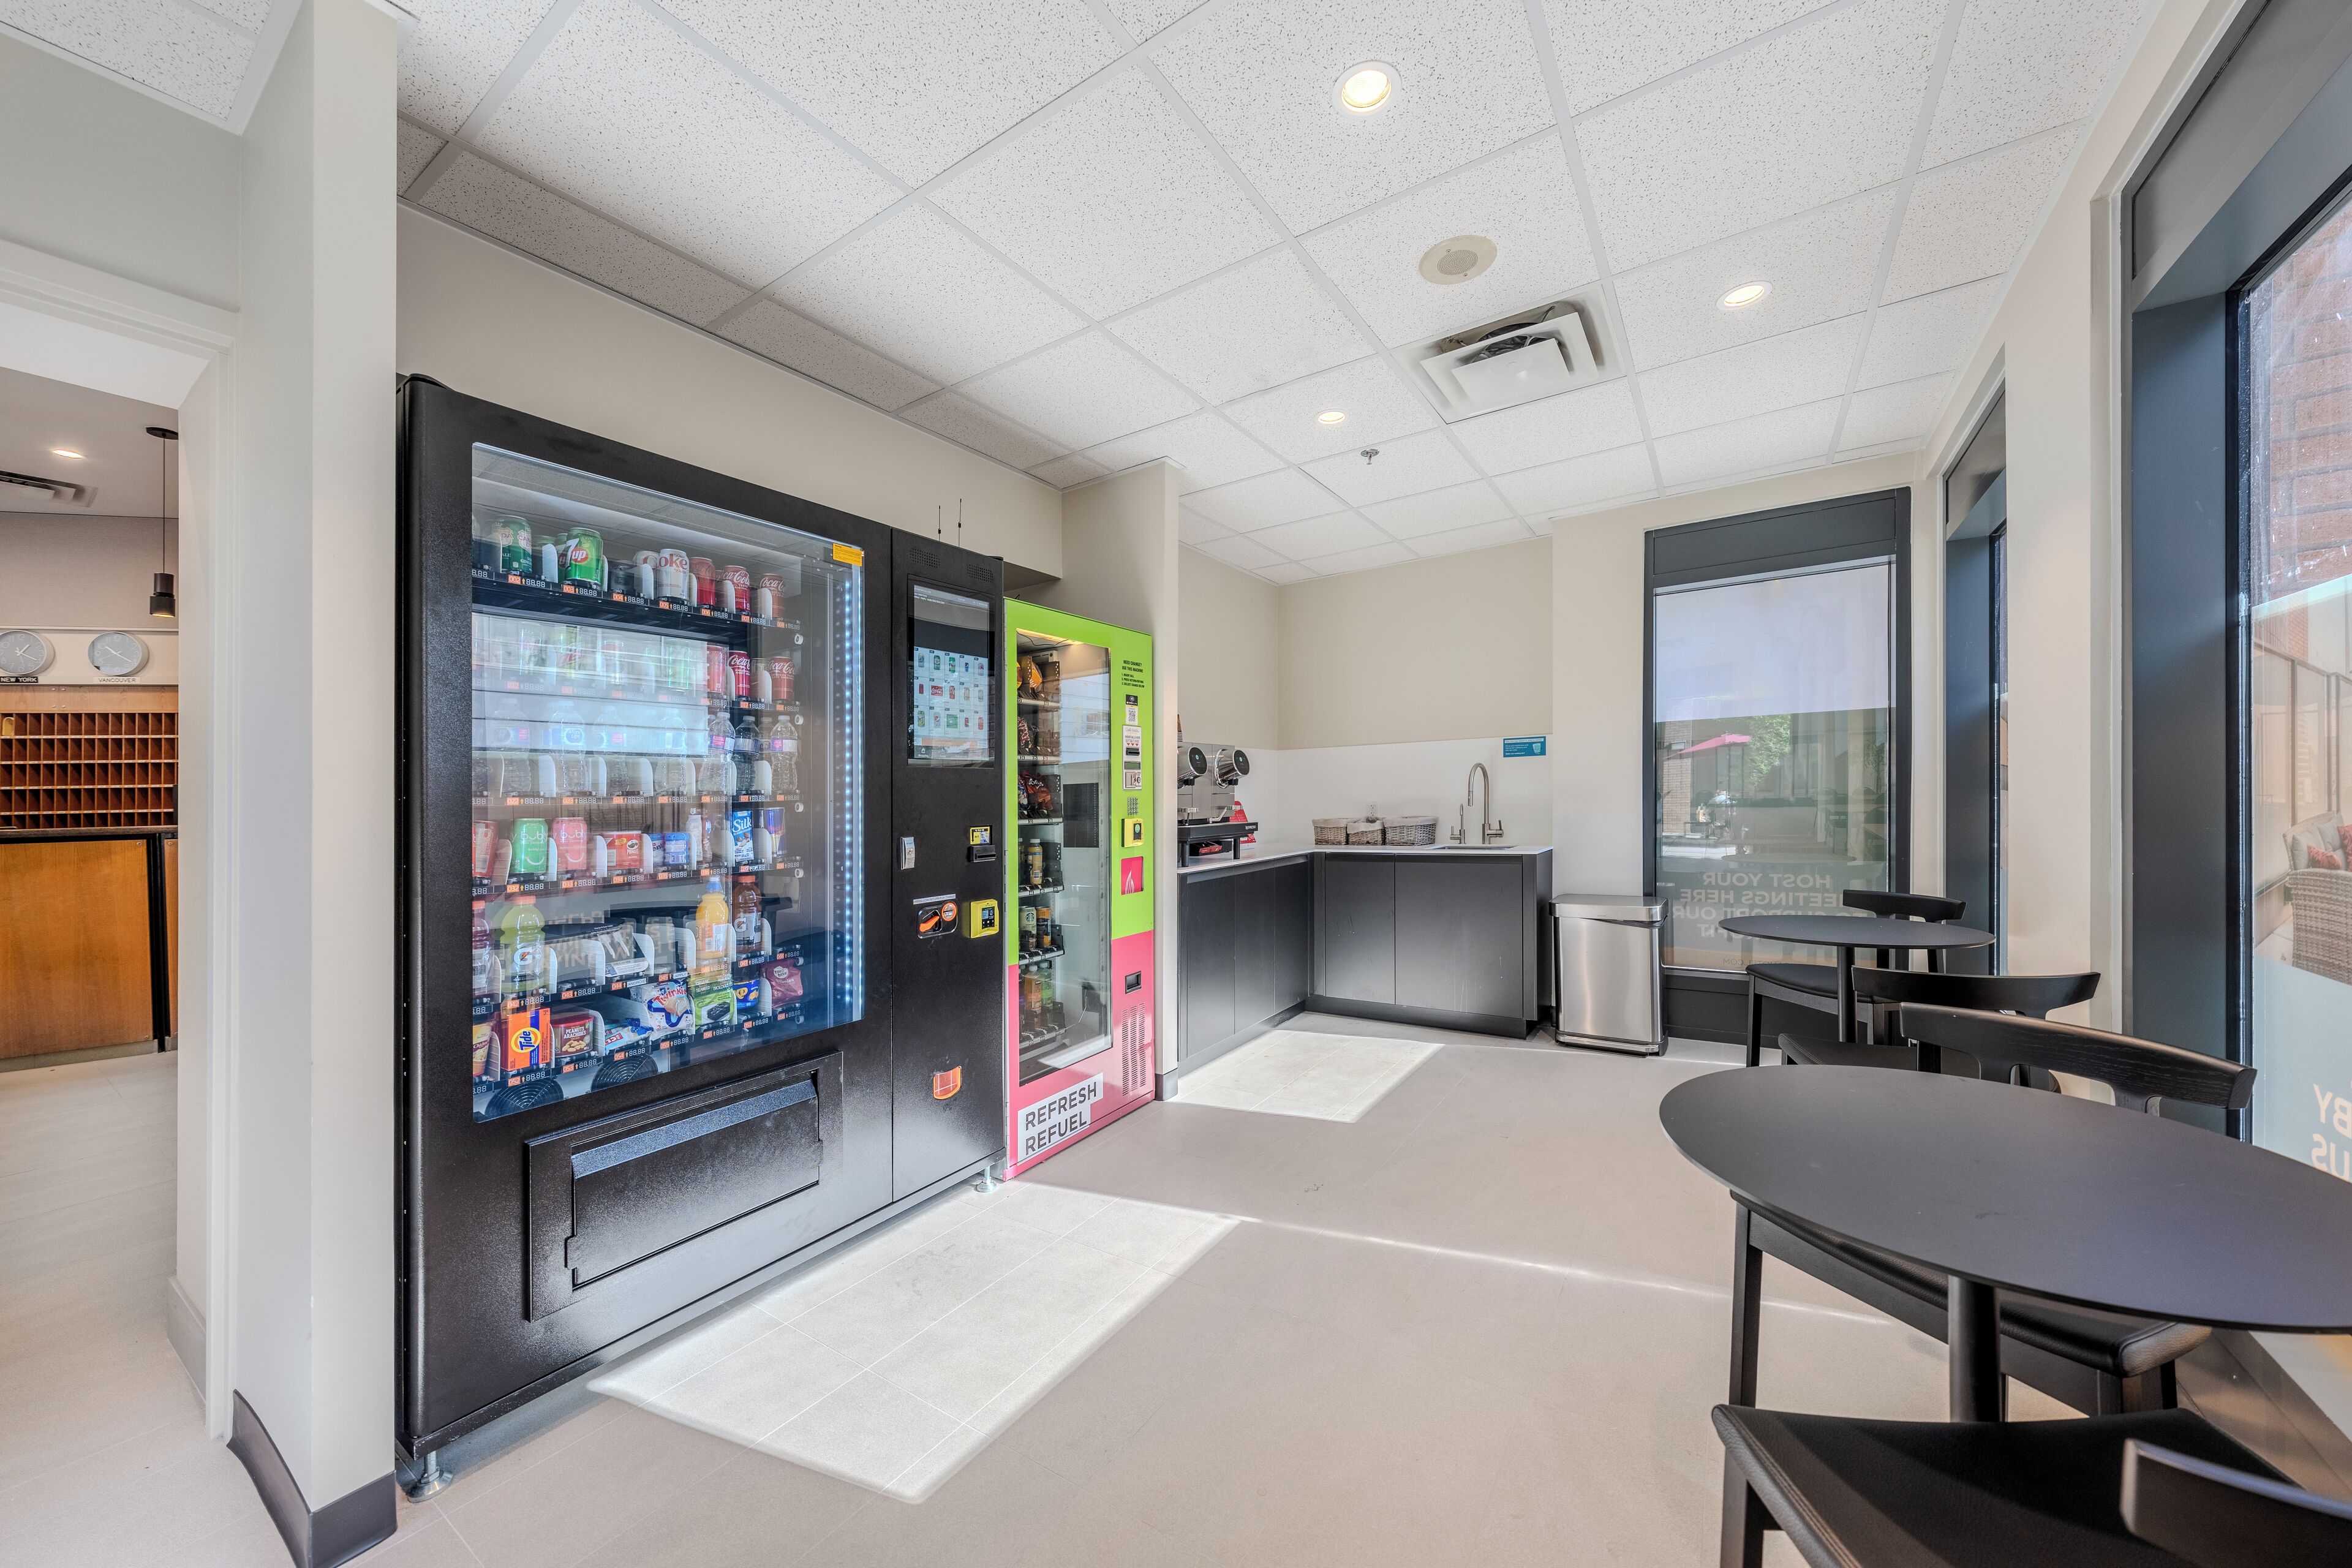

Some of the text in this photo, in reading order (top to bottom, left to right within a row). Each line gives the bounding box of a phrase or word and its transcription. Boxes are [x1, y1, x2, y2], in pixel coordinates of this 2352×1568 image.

[526, 579, 546, 588] 88.88
[733, 816, 752, 833] Silk
[525, 997, 545, 1005] 88.88
[564, 1030, 586, 1039] ARACHIDES
[565, 1026, 585, 1035] PEANUTS
[519, 1030, 536, 1051] Tide
[628, 1047, 646, 1057] 88.88
[579, 1059, 597, 1069] 88.88
[526, 1071, 545, 1082] 88.88
[1026, 1082, 1096, 1131] REFRESH
[1026, 1111, 1087, 1156] REFUEL
